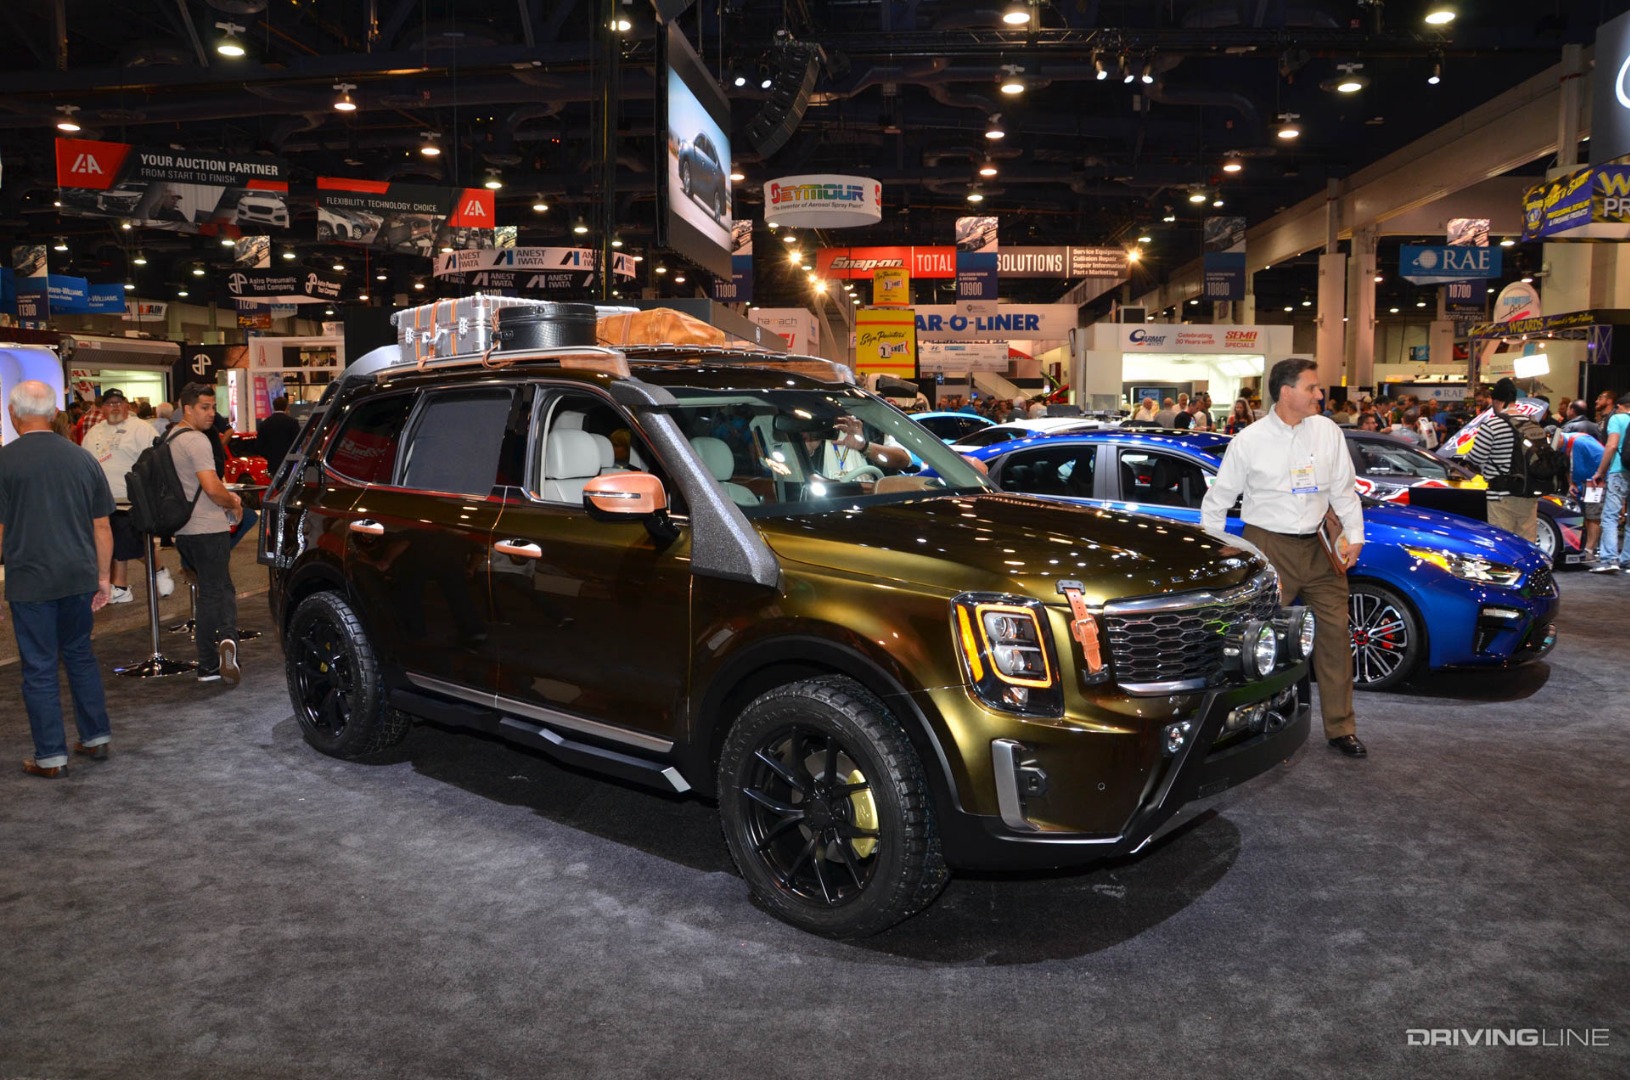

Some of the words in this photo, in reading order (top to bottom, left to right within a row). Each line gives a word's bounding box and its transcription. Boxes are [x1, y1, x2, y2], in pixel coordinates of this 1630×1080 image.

[140, 153, 172, 168] YOUR
[175, 156, 226, 171] AUCTION
[229, 160, 278, 176] PARTNER
[140, 167, 166, 178] FROM
[168, 170, 193, 180] START
[196, 172, 207, 181] TO
[209, 173, 238, 184] FINISH.
[1598, 171, 1630, 197] W
[770, 183, 865, 204] SEYMOUR
[326, 197, 366, 207] FLEXIBILITY.
[368, 200, 412, 210] TECHNOLOGY.
[413, 204, 438, 212] CHOICE.
[1603, 198, 1630, 217] PR
[458, 251, 480, 260] ANEST
[516, 249, 545, 258] ANEST
[1442, 250, 1490, 270] RAE
[517, 257, 545, 266] IWATA
[830, 257, 904, 271] Snap-on
[916, 254, 953, 272] TOTAL
[997, 254, 1063, 272] SOLUTIONS
[266, 276, 297, 284] Pneumatic
[490, 272, 516, 281] ANEST
[547, 273, 573, 282] ANEST
[1088, 269, 1119, 277] Marketing
[491, 280, 514, 288] IWATA
[548, 281, 571, 289] IWATA
[715, 284, 737, 298] 11000
[959, 282, 983, 296] 10900
[1448, 284, 1472, 298] 10700
[18, 303, 37, 317] 11300
[915, 313, 1040, 332] AR-O-LINER
[1508, 318, 1544, 334] WIZARDS
[1177, 332, 1213, 340] Celebrating
[1225, 331, 1258, 340] SEMA
[890, 343, 904, 353] SHOT
[1443, 388, 1464, 397] RAE
